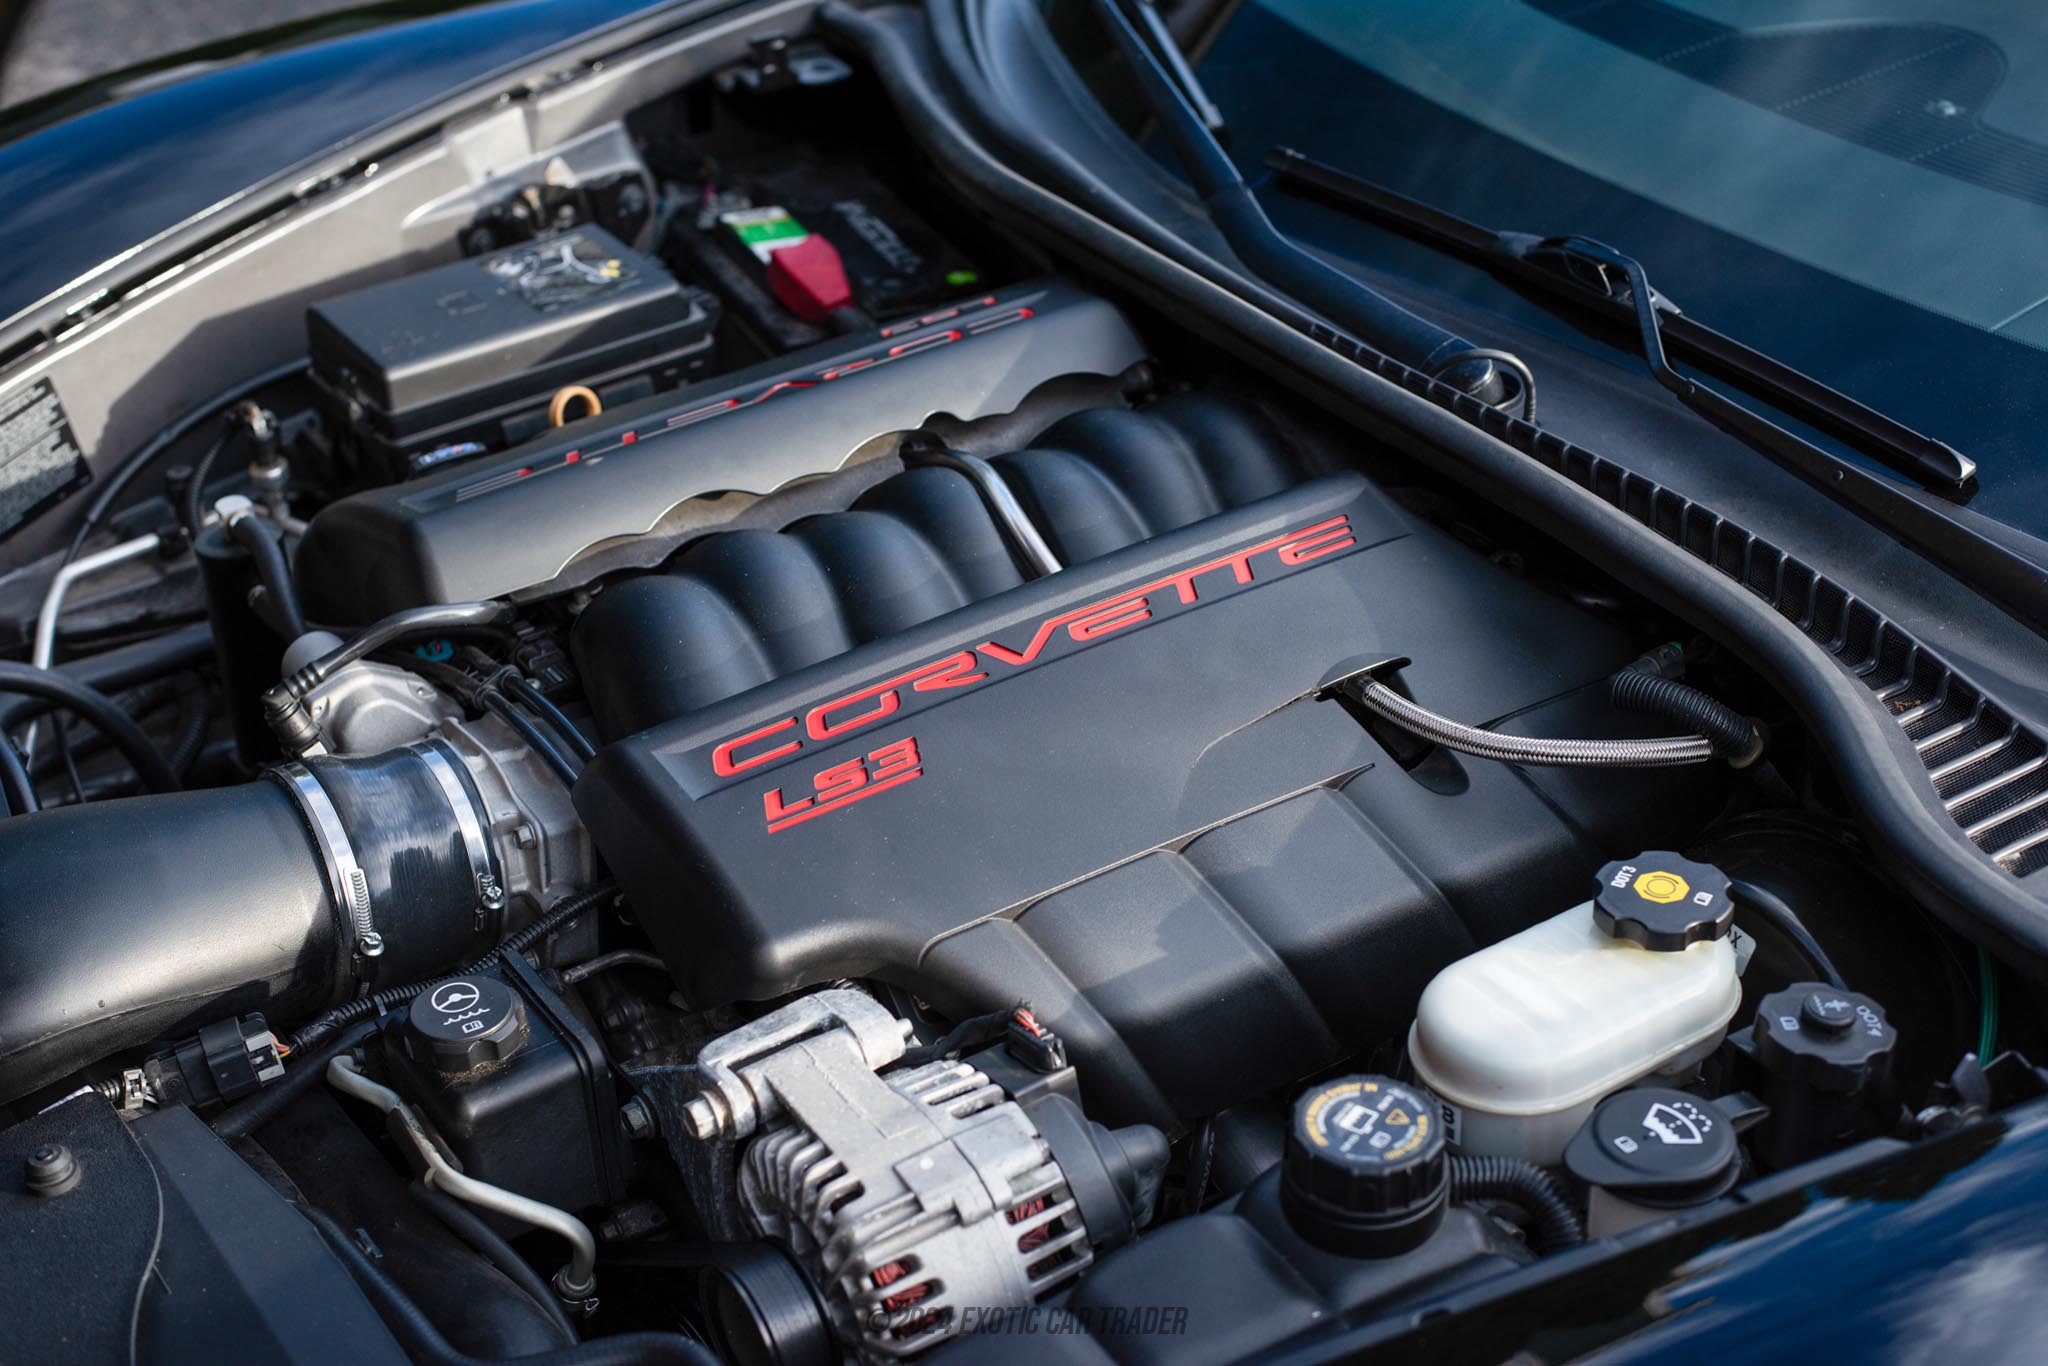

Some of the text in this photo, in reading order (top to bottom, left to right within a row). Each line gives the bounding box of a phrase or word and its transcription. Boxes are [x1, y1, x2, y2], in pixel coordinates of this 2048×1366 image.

[713, 515, 1355, 777] CORVETTE
[764, 736, 923, 827] LS3
[1610, 869, 1632, 888] DOT
